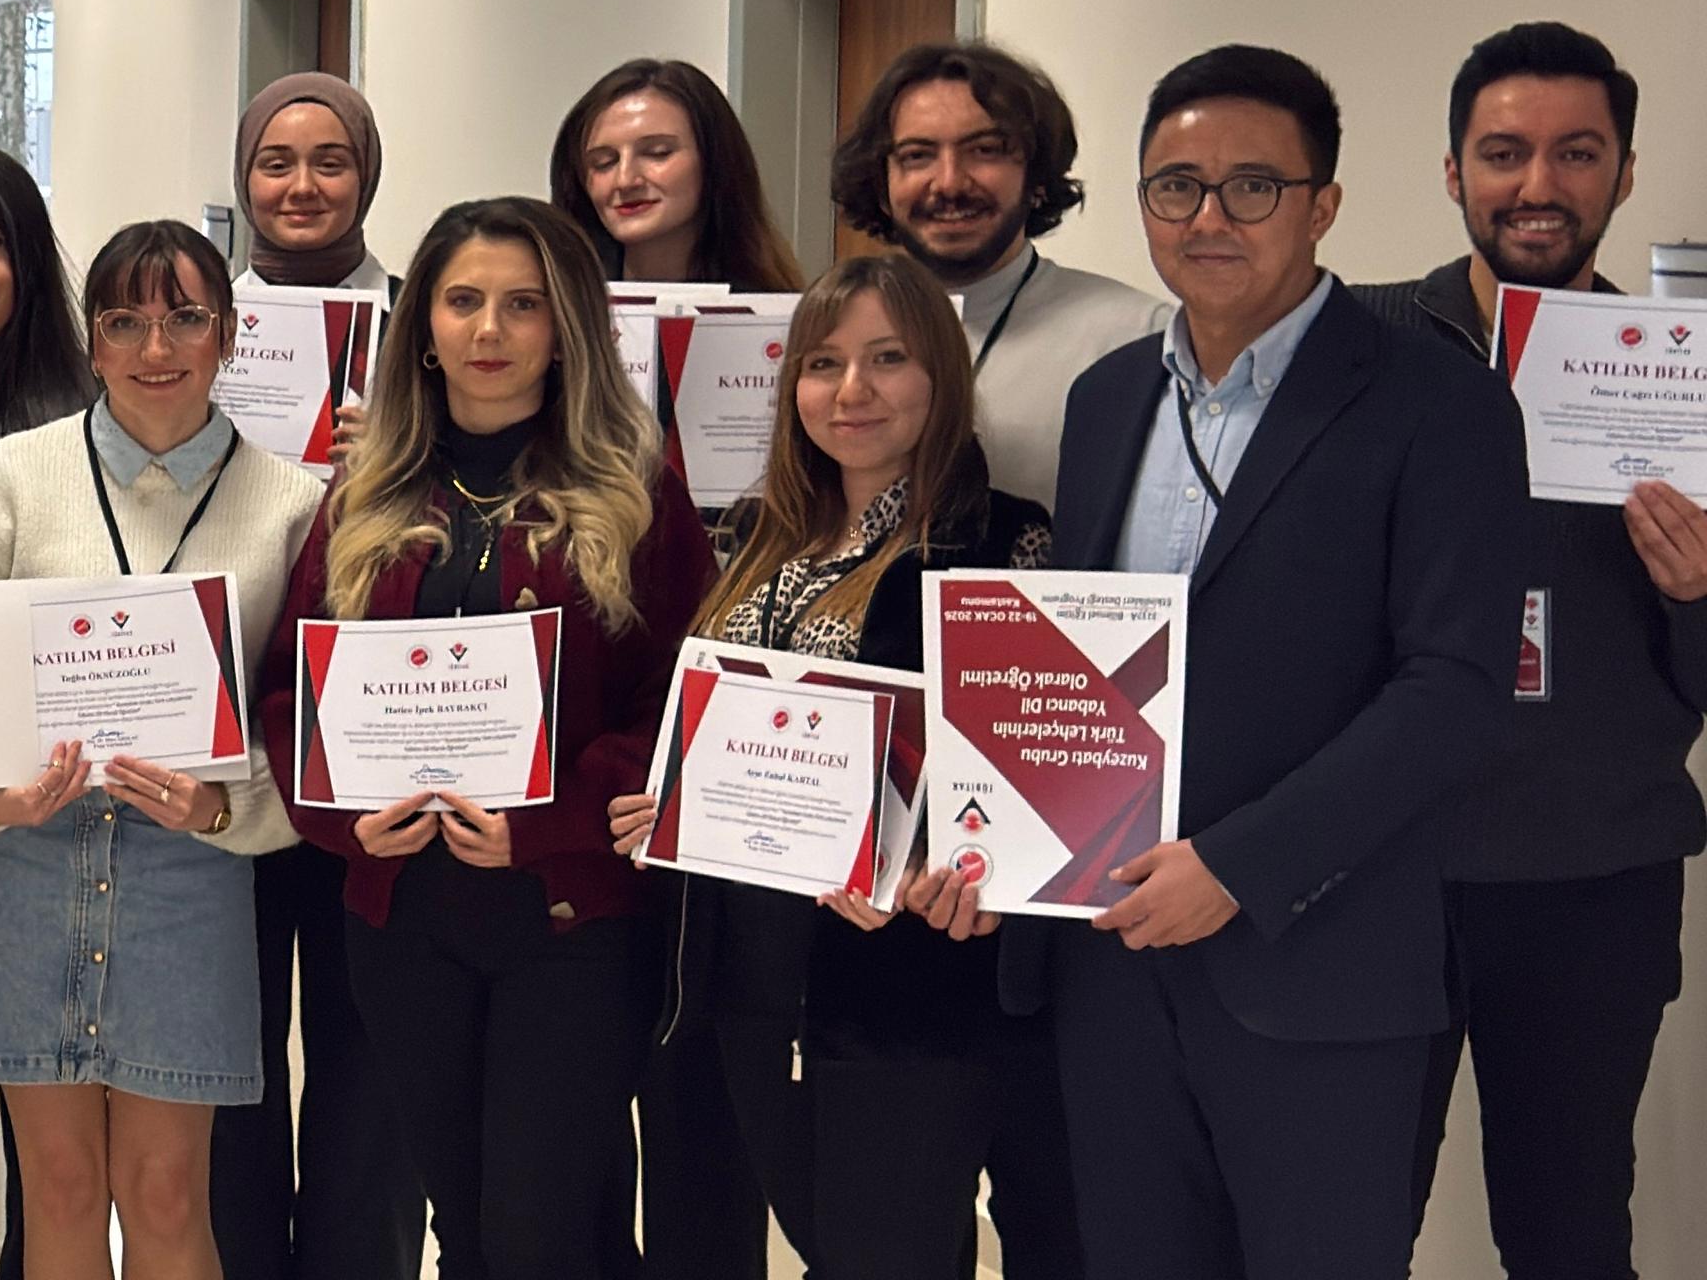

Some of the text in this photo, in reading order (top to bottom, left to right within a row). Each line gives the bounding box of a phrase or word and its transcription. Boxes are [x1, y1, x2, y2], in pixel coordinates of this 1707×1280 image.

[235, 347, 294, 363] ELGESİ
[1563, 359, 1707, 382] KATILIM BELG
[718, 375, 776, 389] KATILI
[961, 597, 1021, 607] Kastamonu
[974, 610, 1005, 622] OCAK
[33, 639, 176, 666] KATILIM BELGESİ
[363, 675, 508, 695] KATILIM BELGESİ
[961, 666, 1088, 691] Olarak Öğretimi
[1021, 697, 1106, 716] Yabancı Dil
[993, 720, 1125, 743] Türk Lehçelerinin
[726, 738, 849, 769] KATILIM BELGESİ
[1021, 748, 1147, 770] Kuzeybatı Grubu
